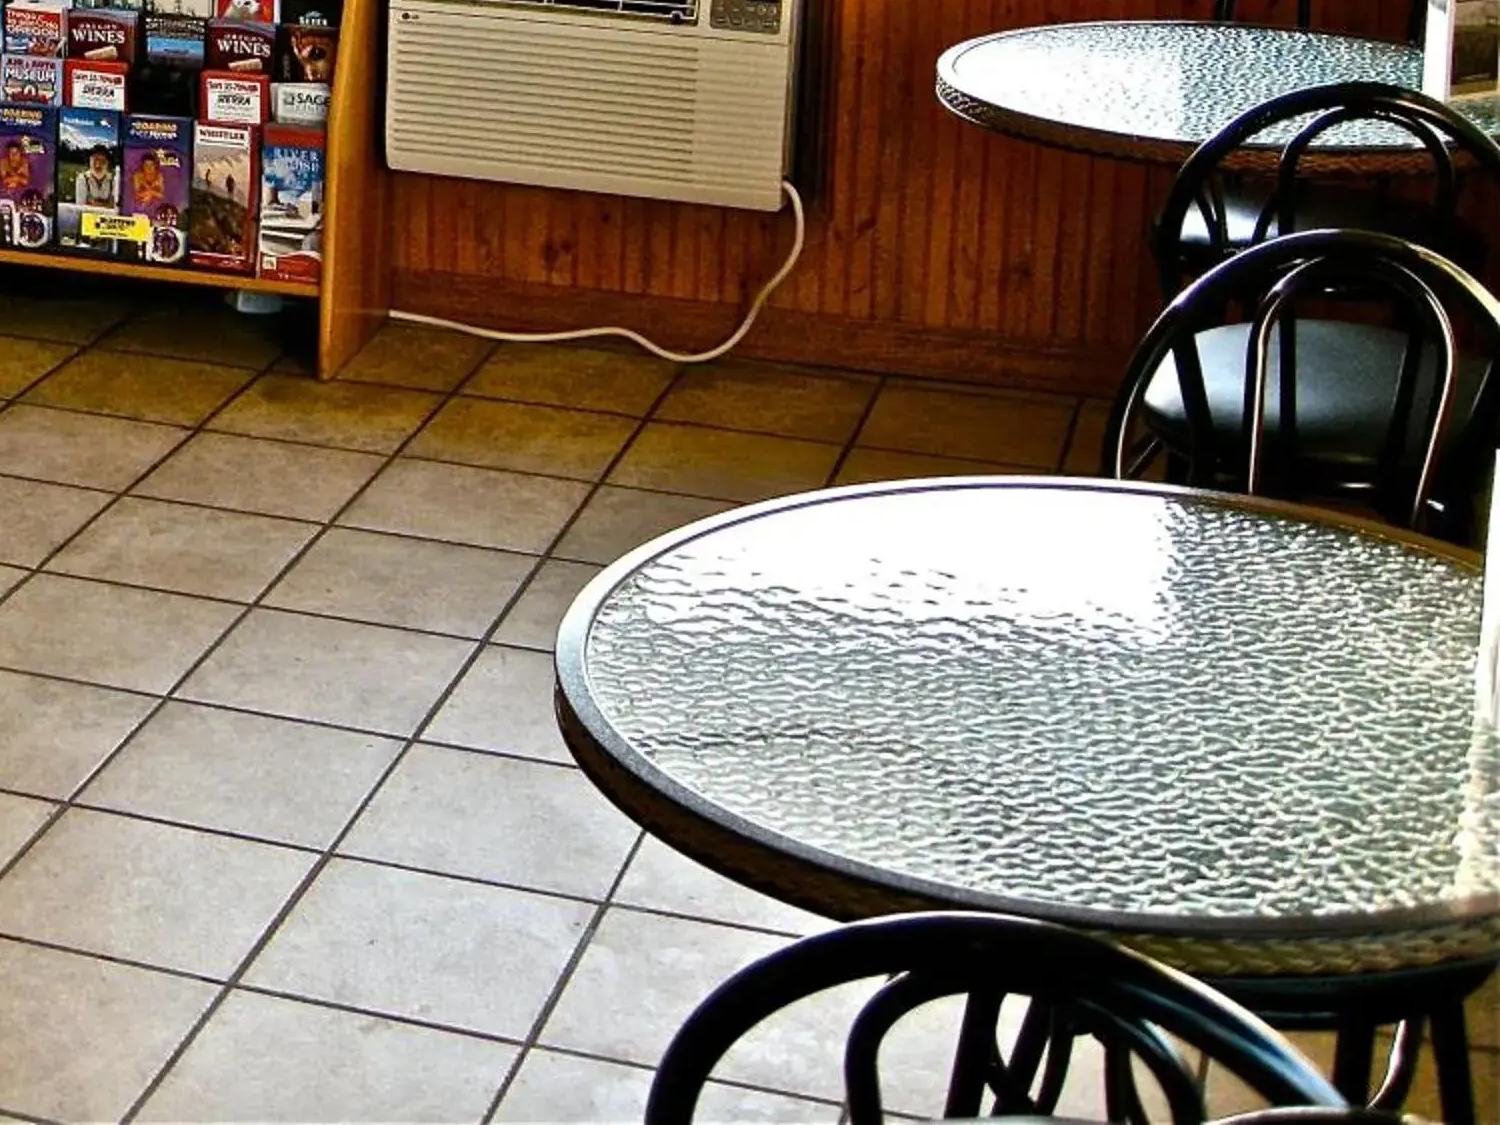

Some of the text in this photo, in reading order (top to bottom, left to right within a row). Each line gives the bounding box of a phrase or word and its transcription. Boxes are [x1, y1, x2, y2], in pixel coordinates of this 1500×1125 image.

[72, 28, 125, 44] WINES
[217, 38, 271, 57] WINES
[5, 66, 55, 82] MUSEUM
